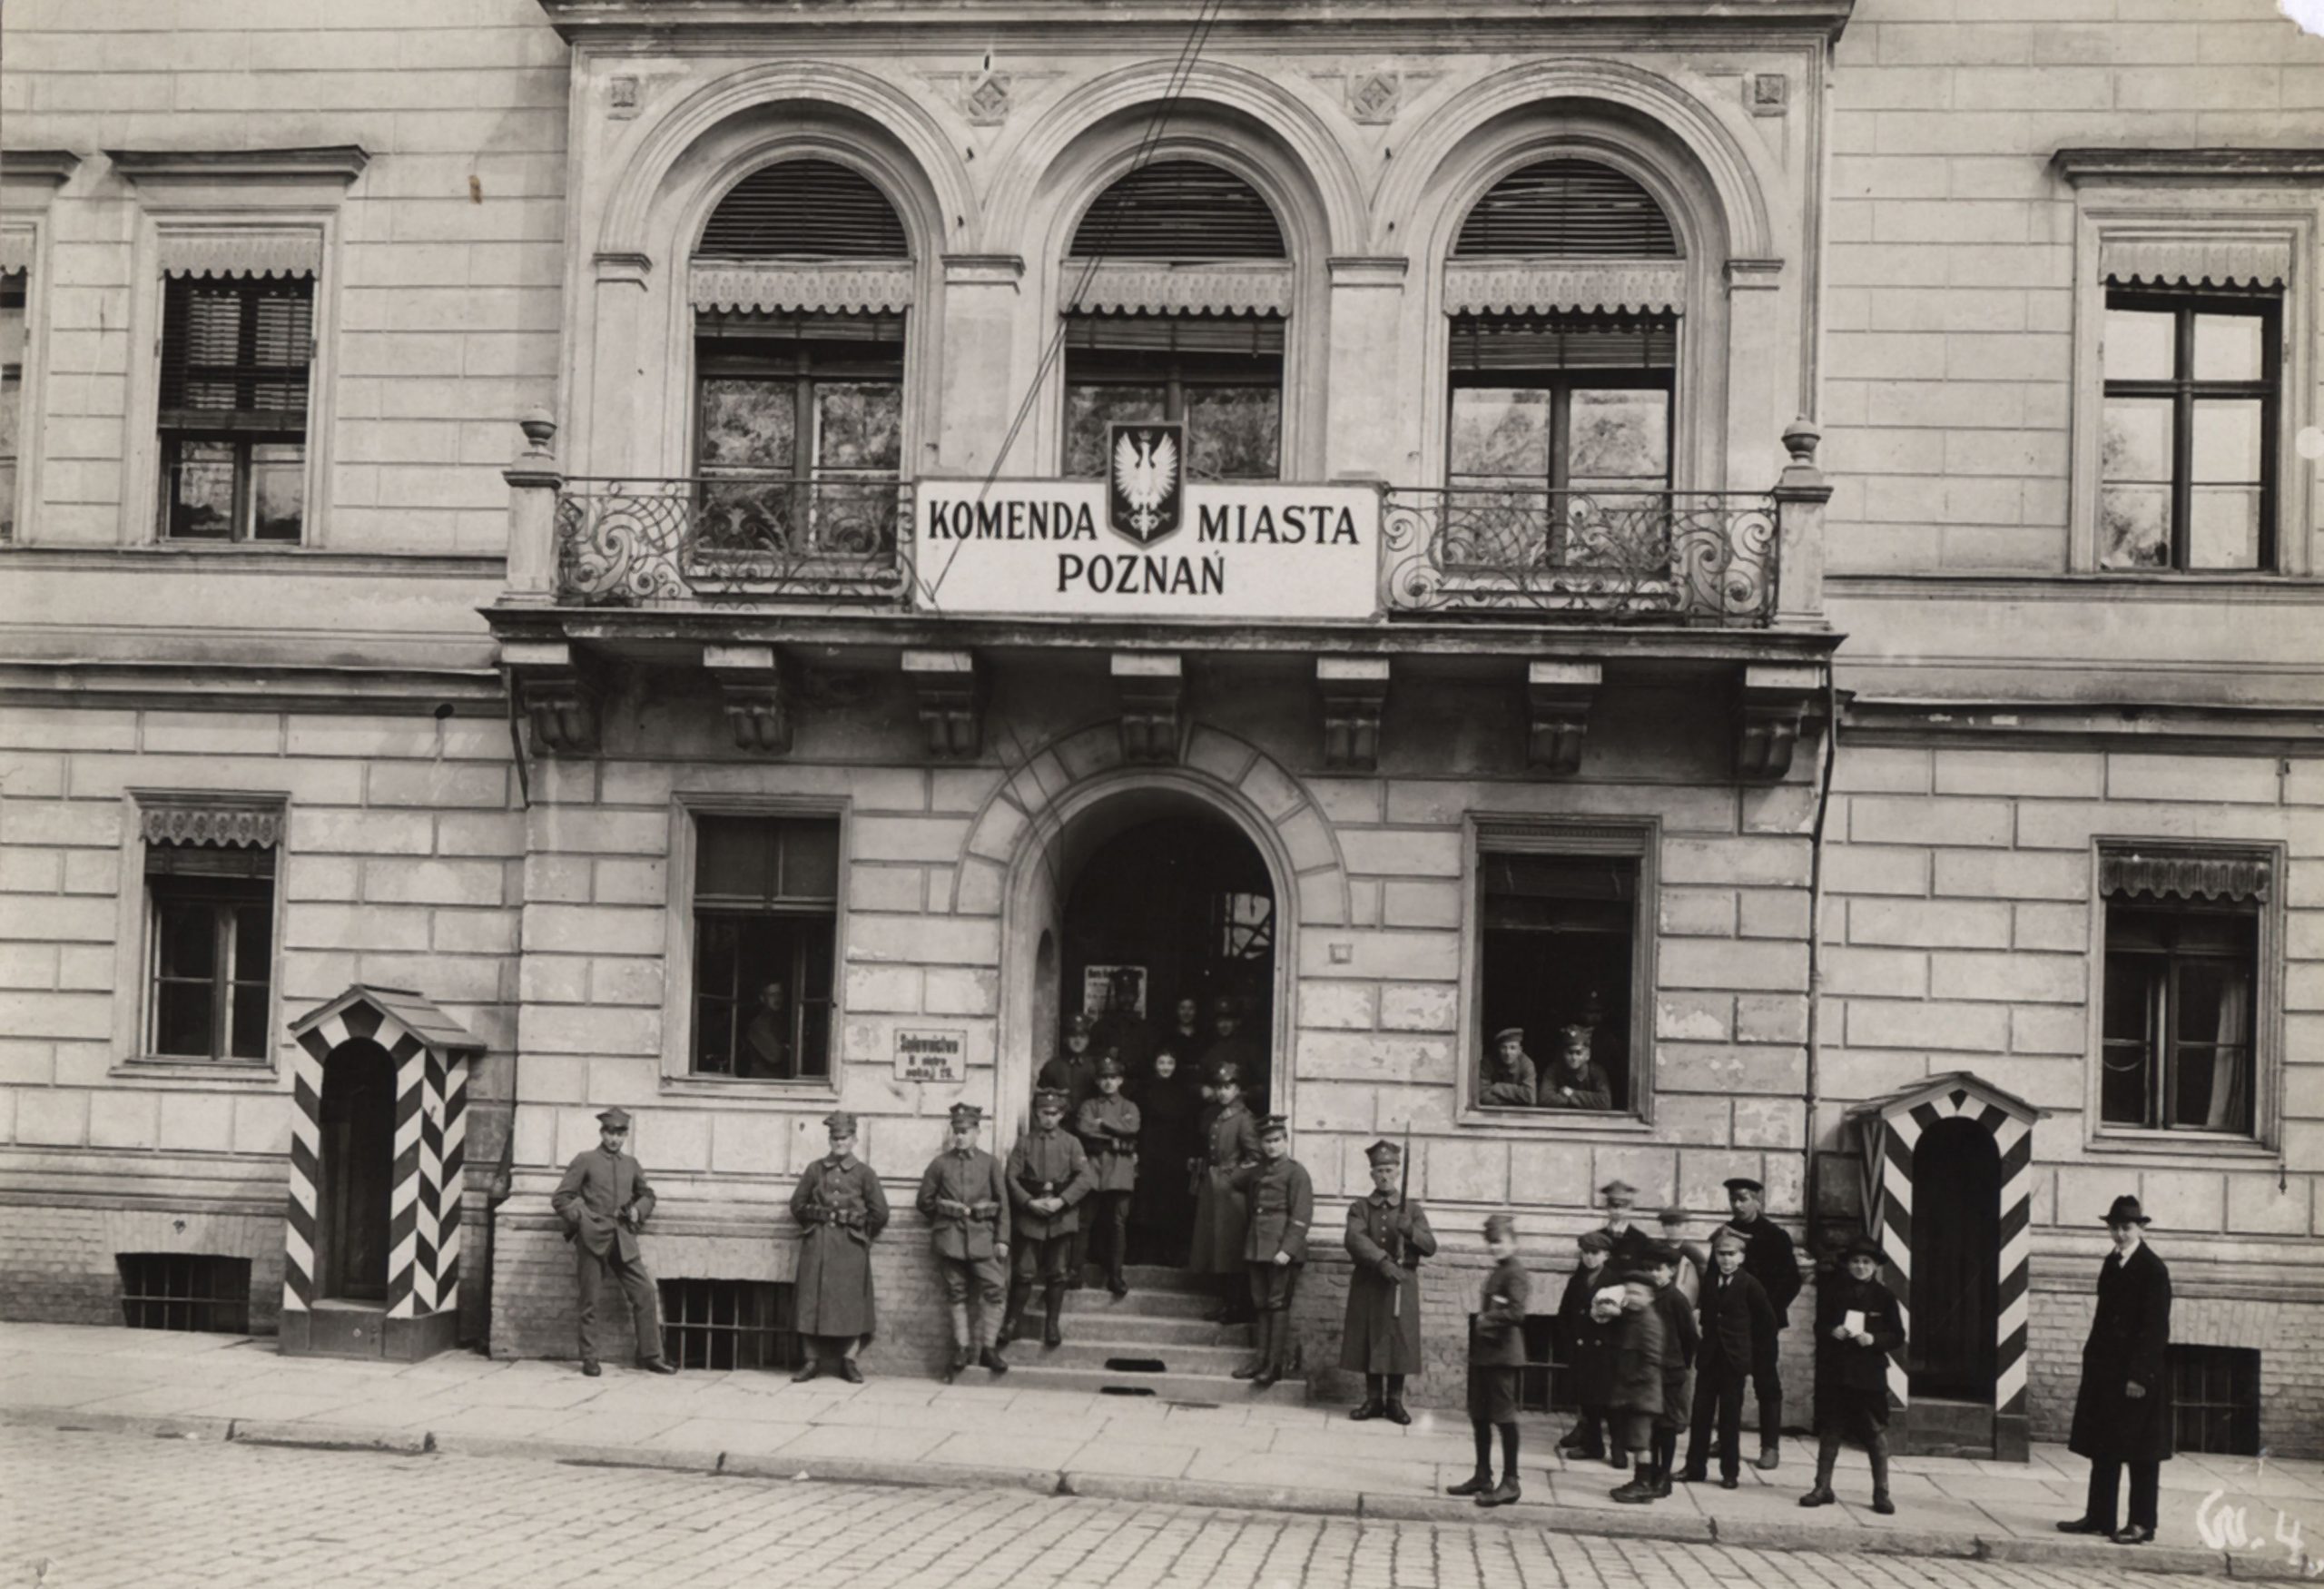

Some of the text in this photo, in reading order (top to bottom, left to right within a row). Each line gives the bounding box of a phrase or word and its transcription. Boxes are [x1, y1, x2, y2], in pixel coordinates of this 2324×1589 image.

[928, 500, 1360, 545] KOMENDA MIASTA
[1058, 549, 1225, 595] POZNAŃ
